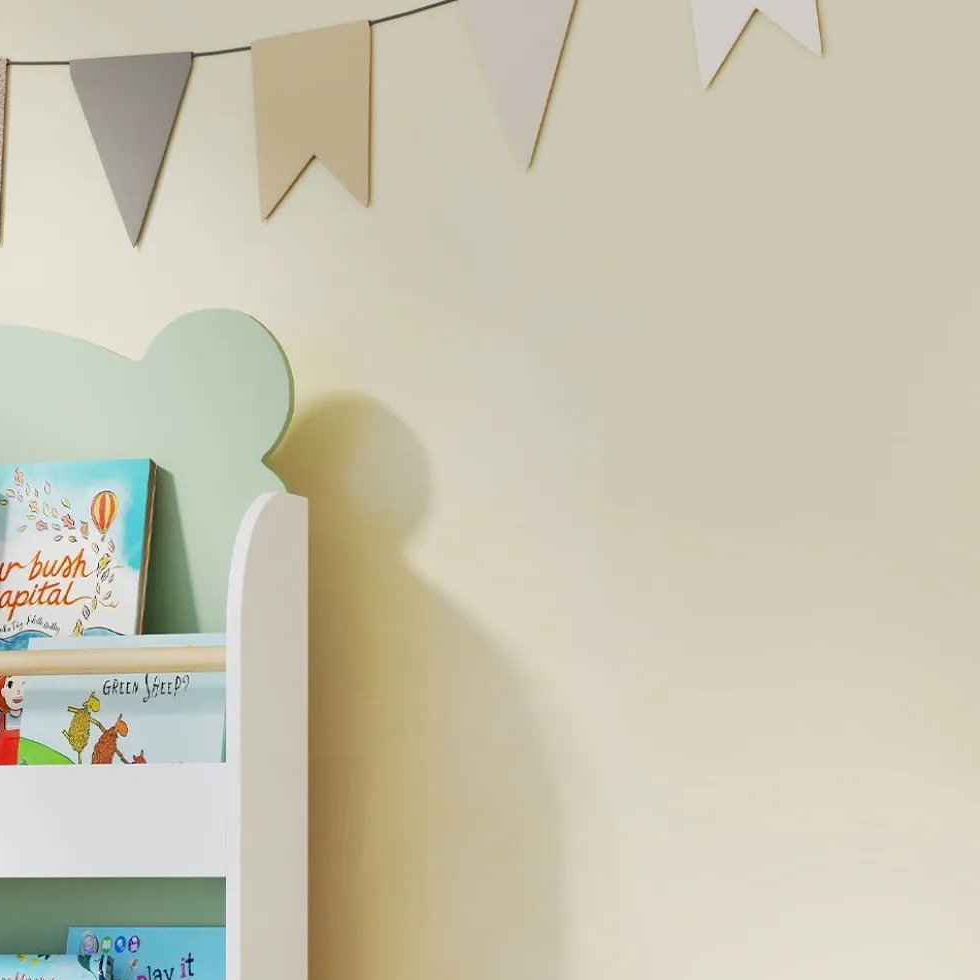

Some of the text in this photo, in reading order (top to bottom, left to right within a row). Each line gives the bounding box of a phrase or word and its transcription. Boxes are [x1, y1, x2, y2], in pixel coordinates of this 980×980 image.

[29, 548, 92, 579] bush
[102, 672, 190, 703] GREEN SHEEP?
[180, 952, 195, 979] it
